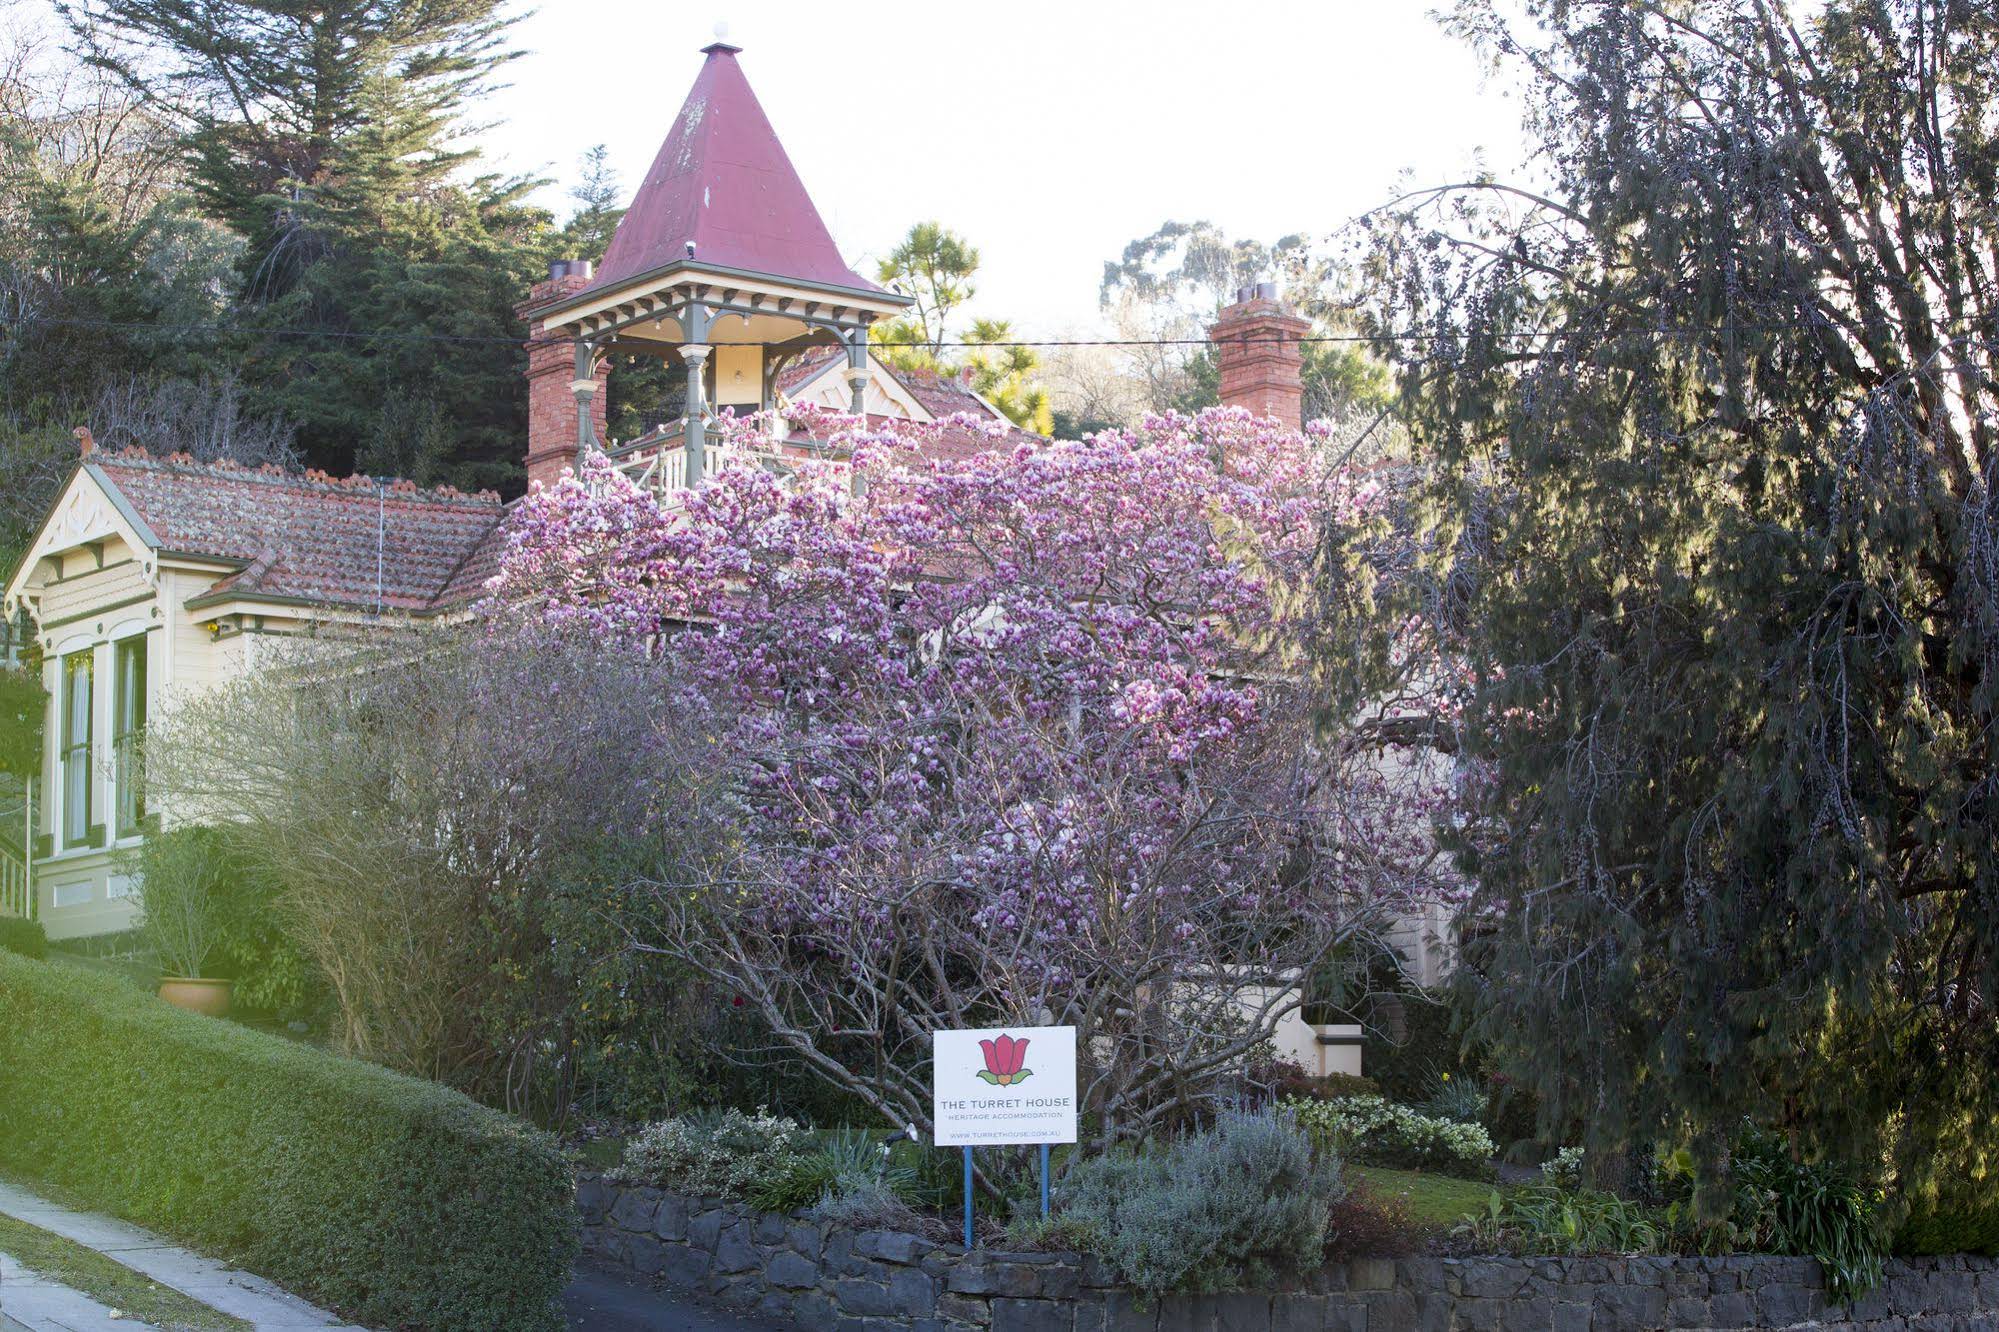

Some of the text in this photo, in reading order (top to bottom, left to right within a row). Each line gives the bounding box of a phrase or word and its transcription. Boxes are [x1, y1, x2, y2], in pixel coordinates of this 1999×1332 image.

[941, 1097, 1070, 1110] THE TURRET HOUSE
[992, 1112, 1063, 1120] ACCOMMODATION
